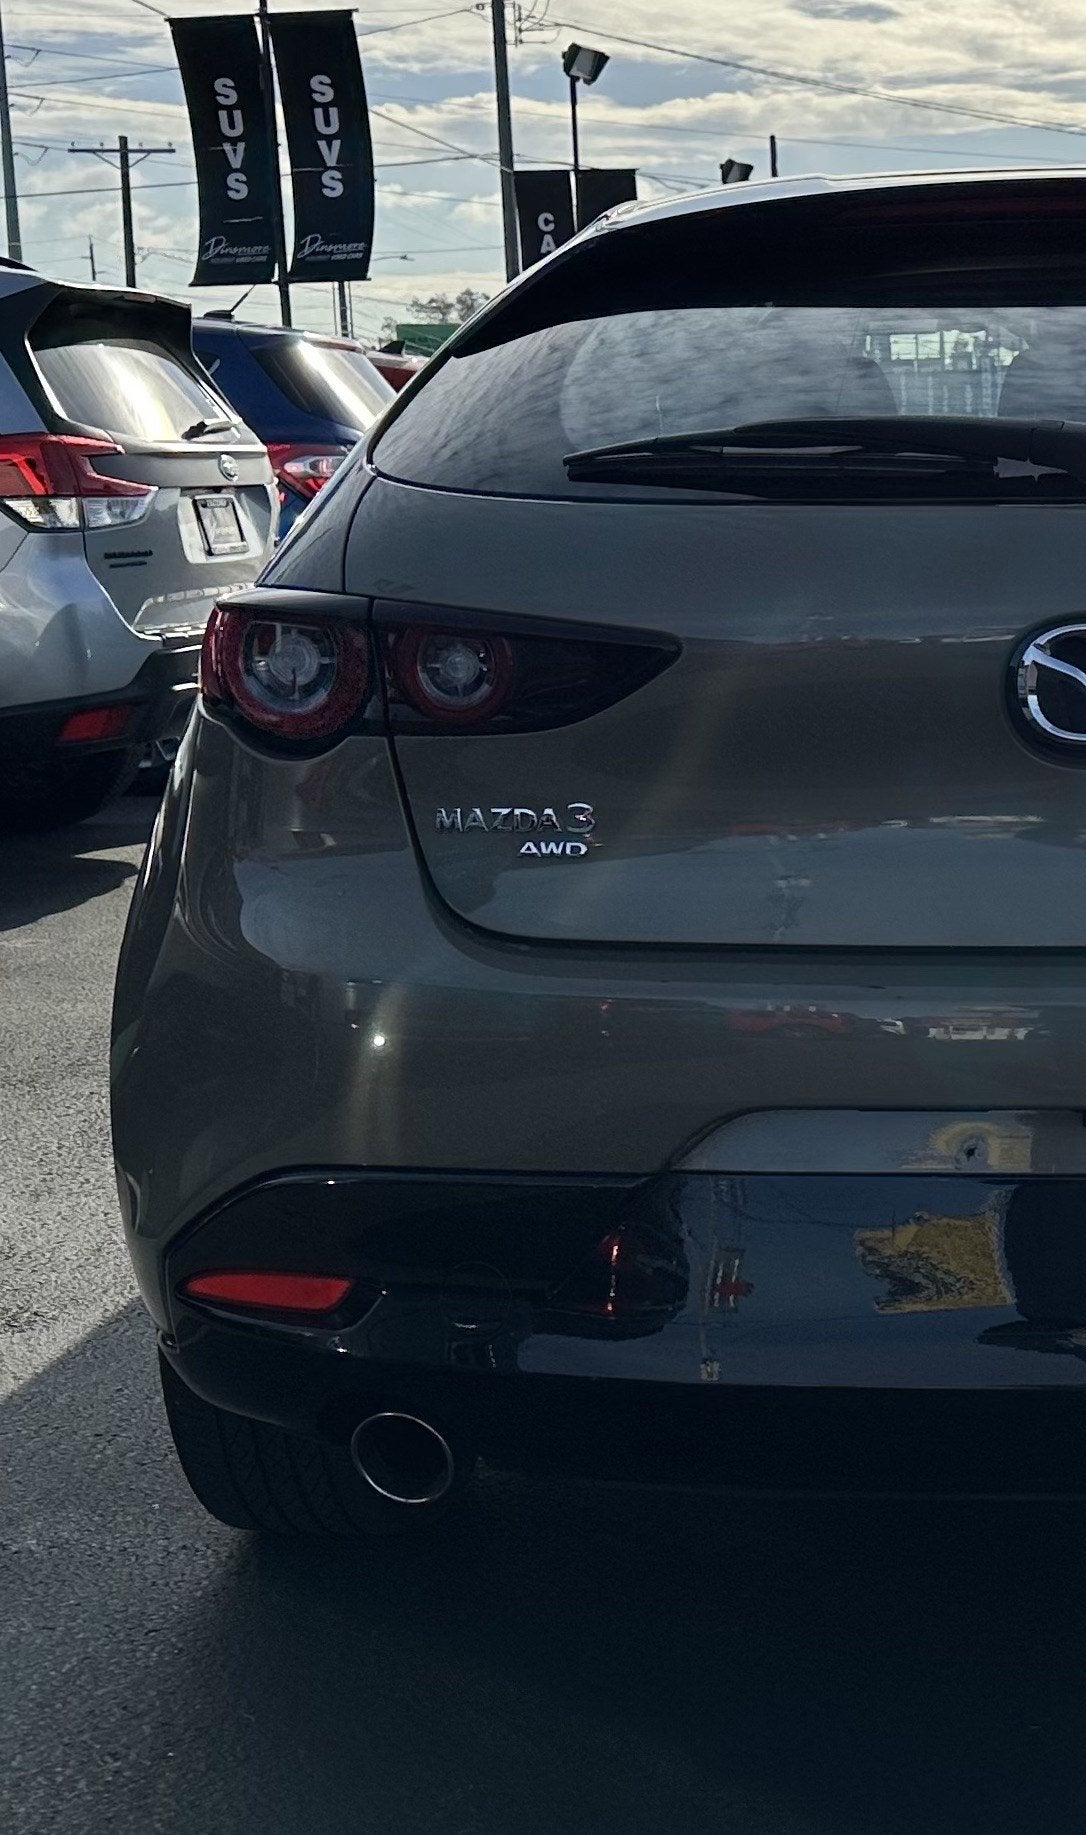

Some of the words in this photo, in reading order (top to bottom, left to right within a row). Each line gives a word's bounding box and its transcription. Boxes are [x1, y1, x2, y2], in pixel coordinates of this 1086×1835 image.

[214, 78, 249, 200] SUVS
[310, 75, 344, 198] SUVS
[517, 841, 588, 857] AWD
